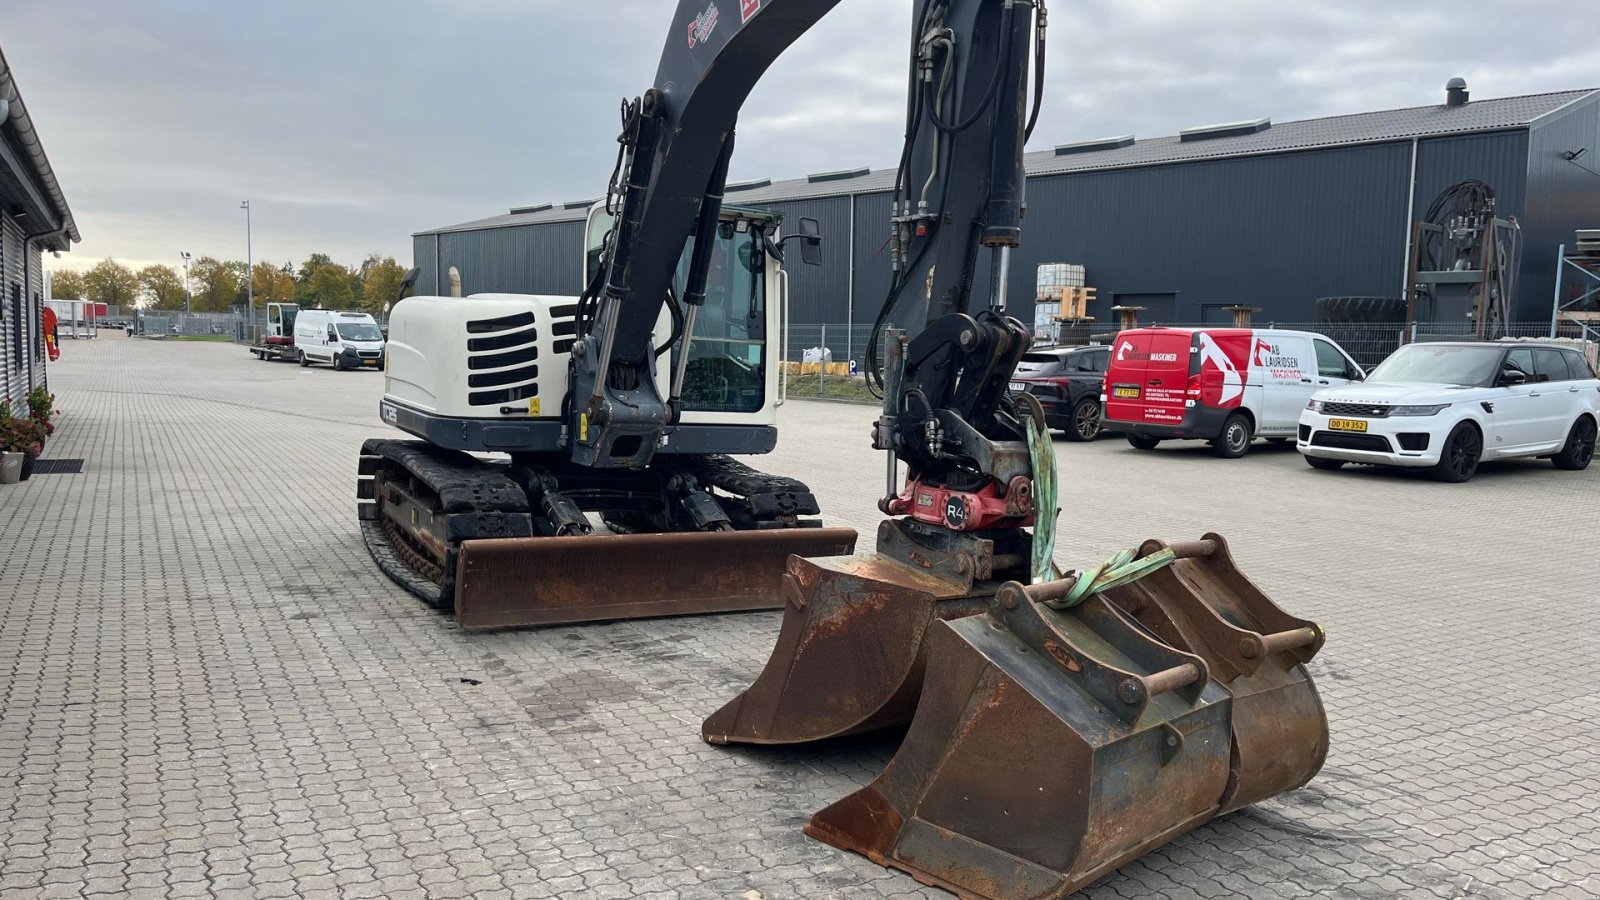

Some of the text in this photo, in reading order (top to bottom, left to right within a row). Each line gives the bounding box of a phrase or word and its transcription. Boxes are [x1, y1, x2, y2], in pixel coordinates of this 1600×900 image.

[1271, 345, 1280, 355] AB
[1150, 353, 1177, 361] MASKINER
[1265, 356, 1298, 368] LAURIDSEN
[849, 360, 857, 372] P
[1331, 420, 1340, 428] DD
[1352, 421, 1364, 429] 352
[947, 504, 964, 519] R4
